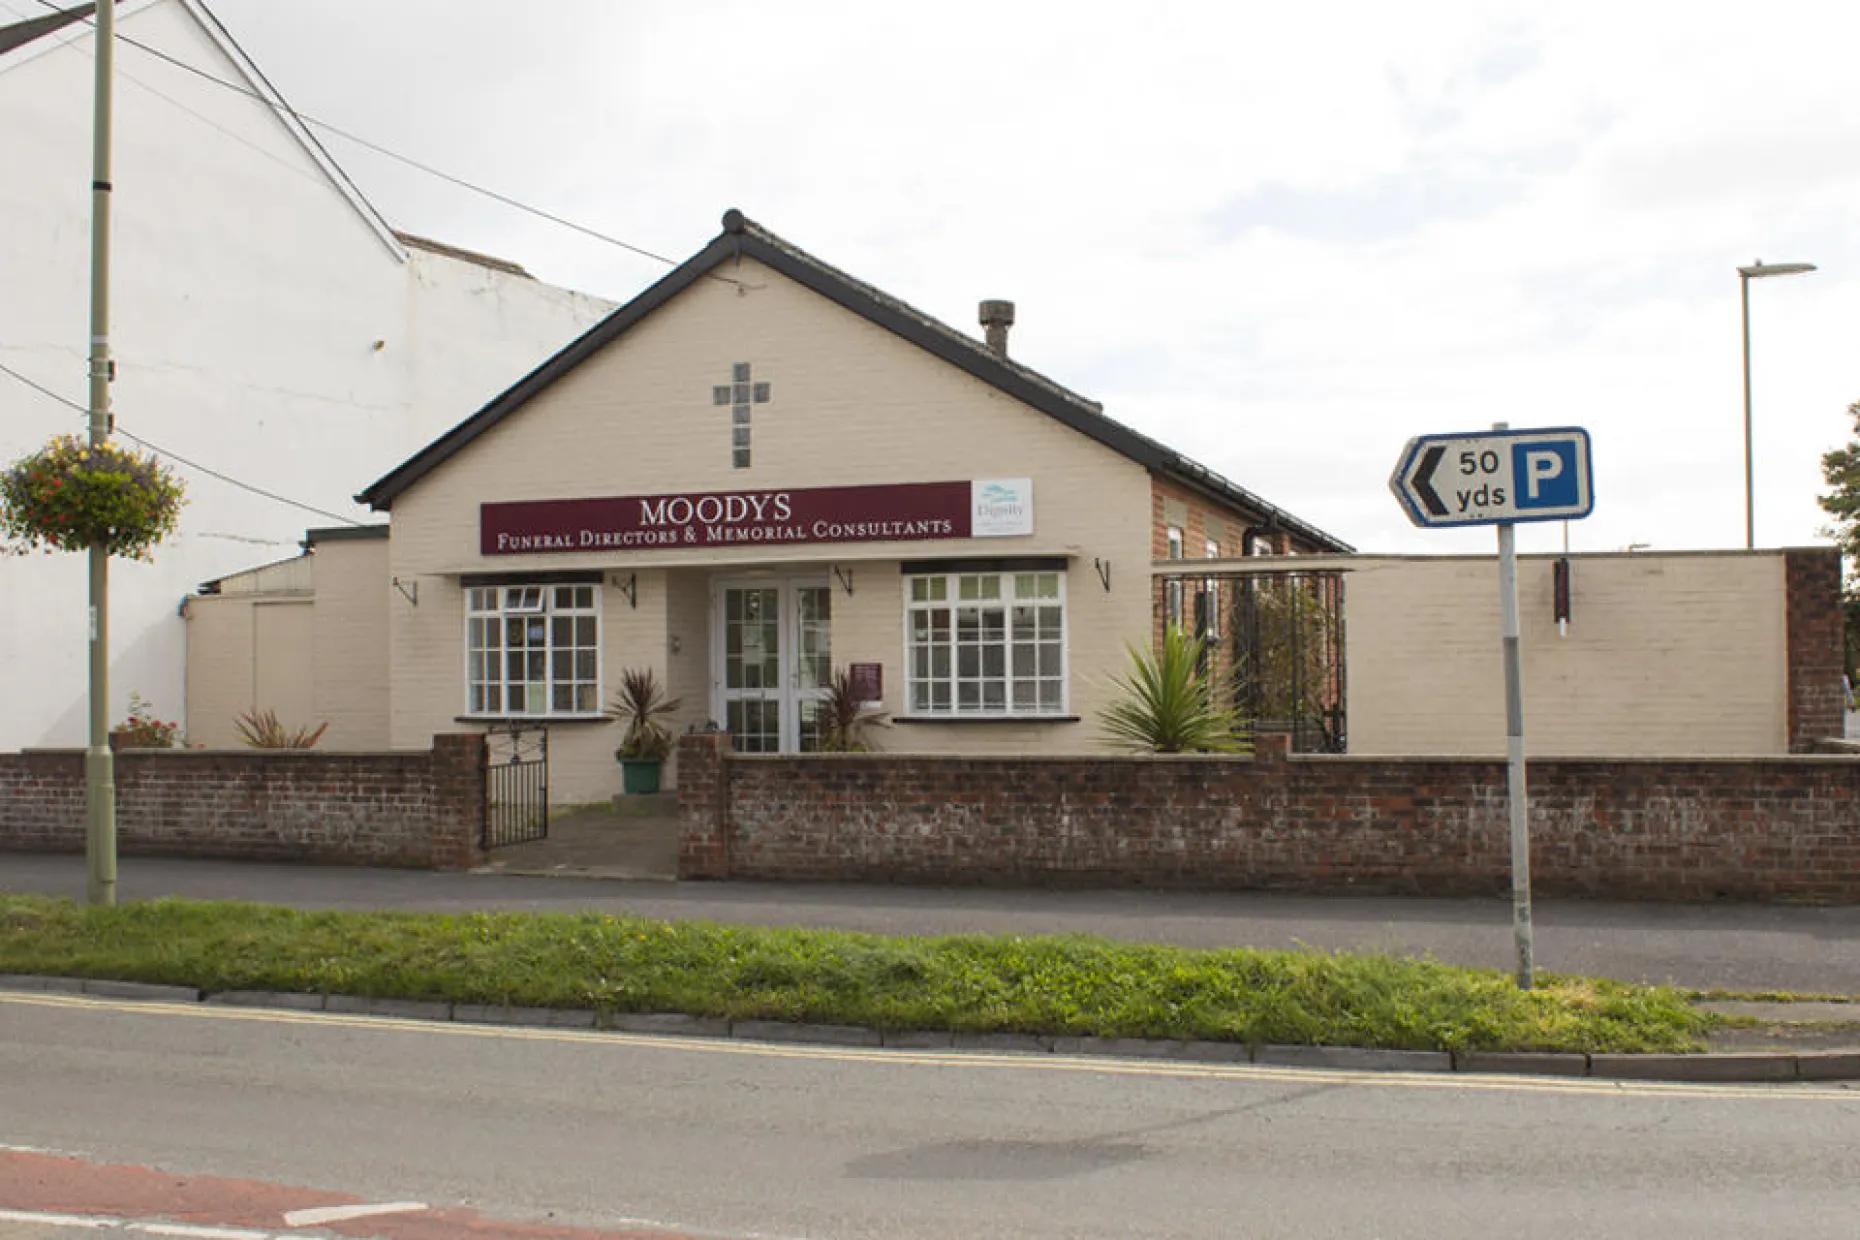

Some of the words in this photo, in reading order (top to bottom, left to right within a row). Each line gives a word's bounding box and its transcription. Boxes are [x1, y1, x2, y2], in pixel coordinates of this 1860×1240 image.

[1459, 450, 1499, 476] 50
[1526, 450, 1564, 499] P
[638, 493, 792, 526] MOODYS
[1456, 483, 1506, 512] yds
[497, 532, 575, 549] FUNERAL
[579, 529, 678, 546] DIRECTORS
[683, 525, 697, 543] &
[706, 524, 807, 543] MEMORIAL
[811, 518, 953, 538] CONSULTANTS
